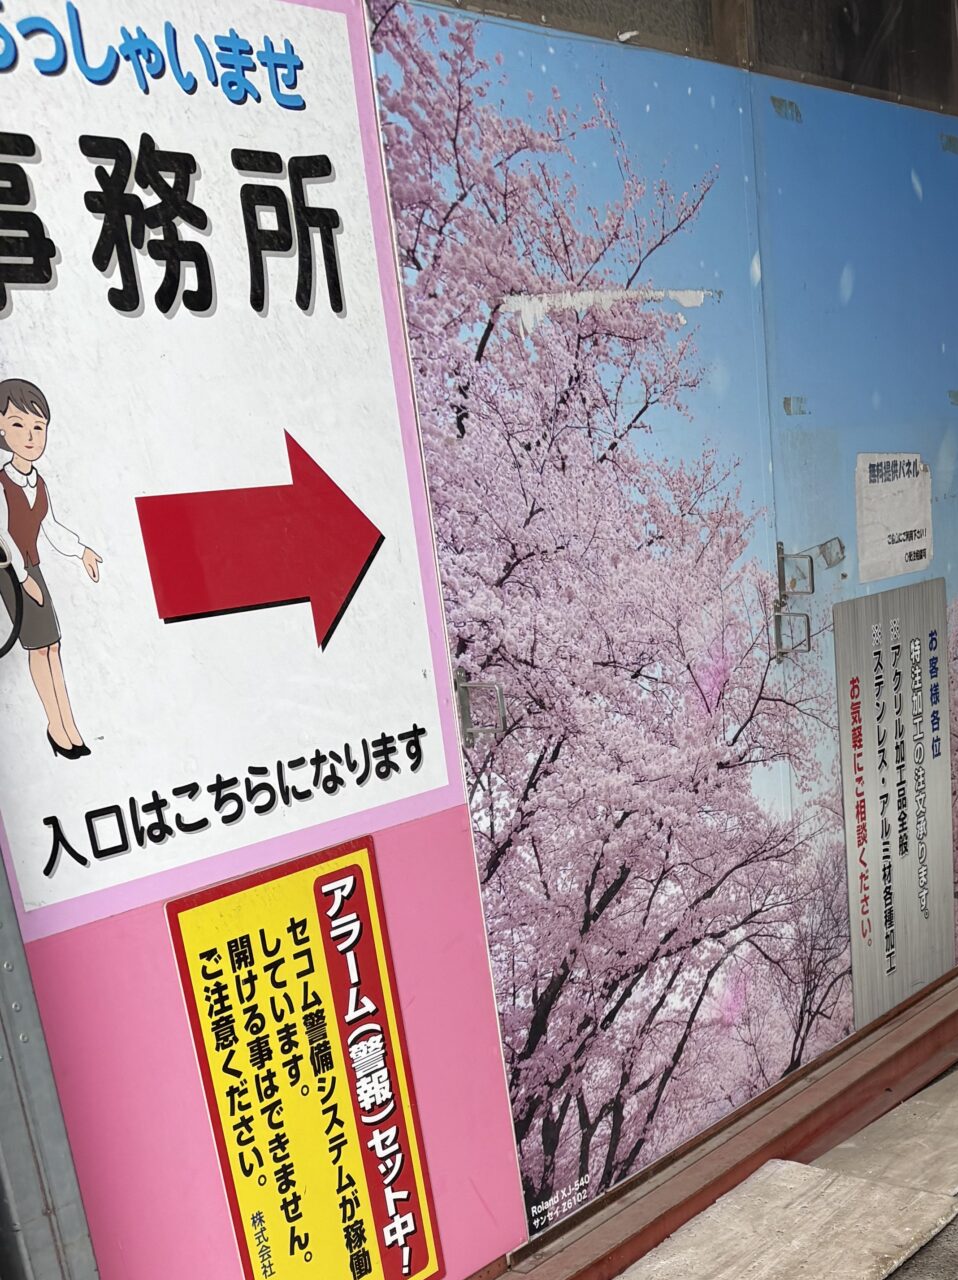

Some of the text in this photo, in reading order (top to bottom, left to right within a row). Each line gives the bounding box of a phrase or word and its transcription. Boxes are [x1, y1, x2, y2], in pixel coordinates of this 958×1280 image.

[868, 458, 920, 484] 無料提供パネル
[928, 630, 942, 759] お客様各位
[43, 723, 428, 877] 入口はこちらになります
[849, 676, 873, 947] お気軽にご相談ください。
[910, 638, 930, 919] 特注加工の注文承ります。
[199, 948, 267, 1187] ご注意ください。
[259, 928, 310, 1097] しています。
[227, 934, 313, 1263] 開ける事はできません。
[250, 1210, 276, 1279] 株式会社
[530, 1174, 591, 1217] Roland XJ-540
